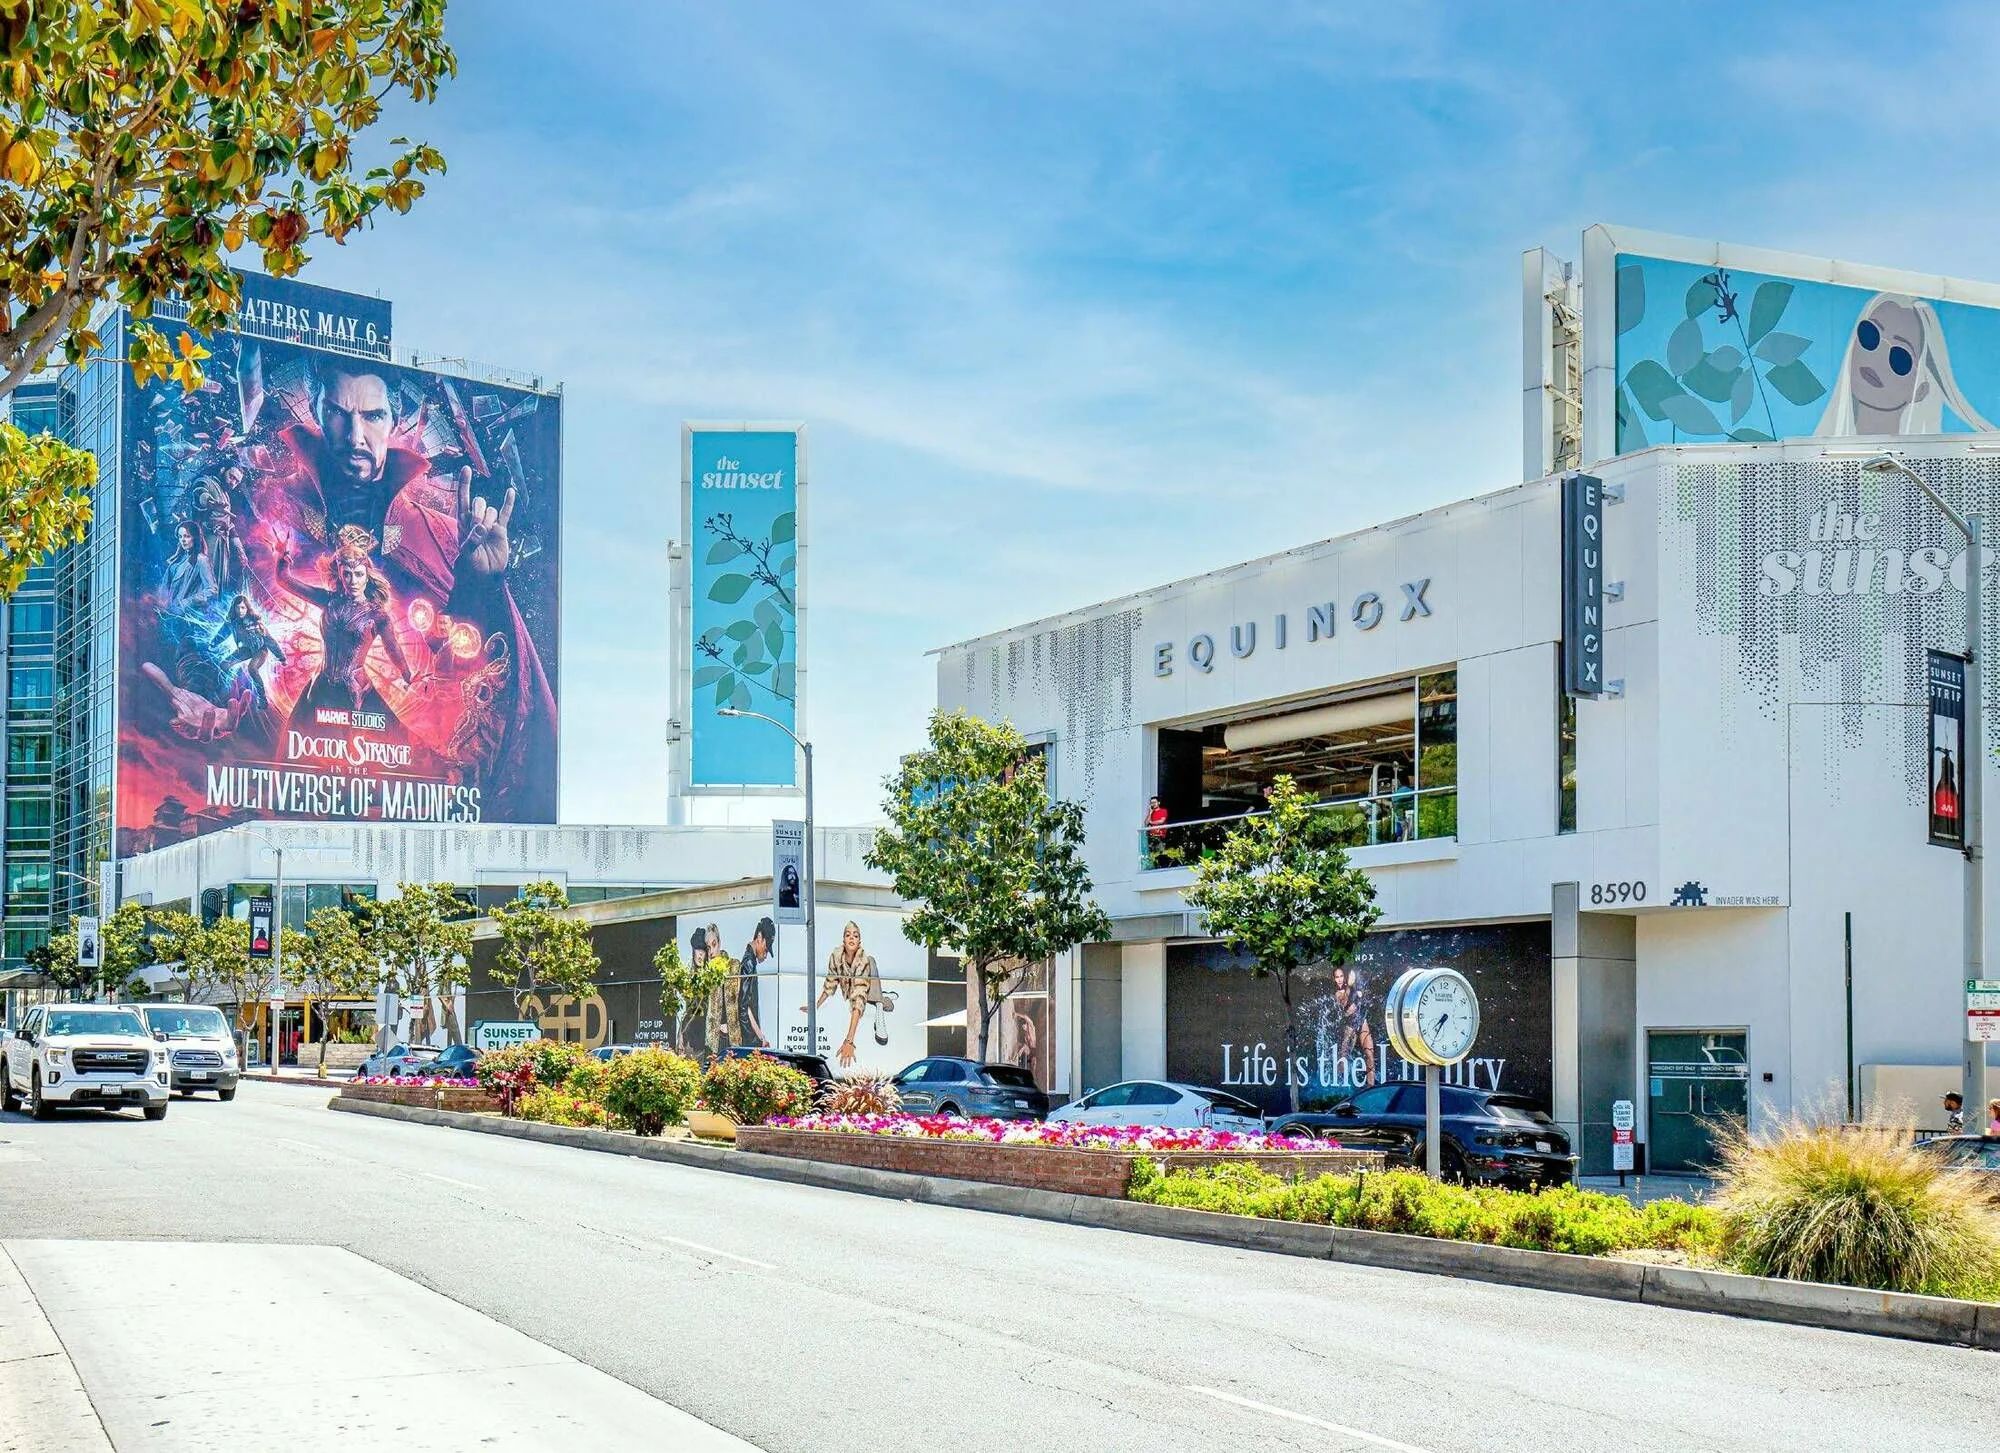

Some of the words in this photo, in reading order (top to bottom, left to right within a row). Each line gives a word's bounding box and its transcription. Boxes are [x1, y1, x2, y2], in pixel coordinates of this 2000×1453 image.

[317, 310, 359, 342] MAY
[365, 322, 378, 346] 6
[717, 455, 740, 471] the
[701, 468, 785, 490] sunset
[1808, 499, 1882, 542] the
[1582, 485, 1599, 683] EQUINOX
[1154, 578, 1432, 678] EQUINOX
[1930, 666, 1962, 684] SUNSET
[1930, 685, 1962, 703] STRIP
[316, 709, 350, 726] MARVEL
[351, 711, 386, 730] STUDIOS
[287, 730, 351, 762] DOCTOR
[350, 735, 412, 768] STRANGE
[348, 766, 369, 776] THE
[206, 764, 346, 816] MULTIVERSE
[351, 777, 377, 817] OF
[381, 779, 481, 824] MADNESS
[775, 829, 801, 837] SUNSET
[775, 838, 802, 847] STRIP
[1590, 880, 1647, 905] 8590
[1715, 895, 1744, 906] INVADER
[1745, 895, 1761, 906] WAS
[1762, 896, 1780, 906] HERE
[1968, 981, 1975, 989] 2
[483, 1028, 534, 1039] SUNSET
[639, 1020, 652, 1029] POP
[653, 1020, 663, 1029] UP
[791, 1026, 809, 1034] POP
[634, 1031, 649, 1040] NOW
[650, 1031, 669, 1040] OPEN
[1221, 1043, 1277, 1086] Life
[1285, 1045, 1309, 1087] is
[1317, 1043, 1367, 1086] the
